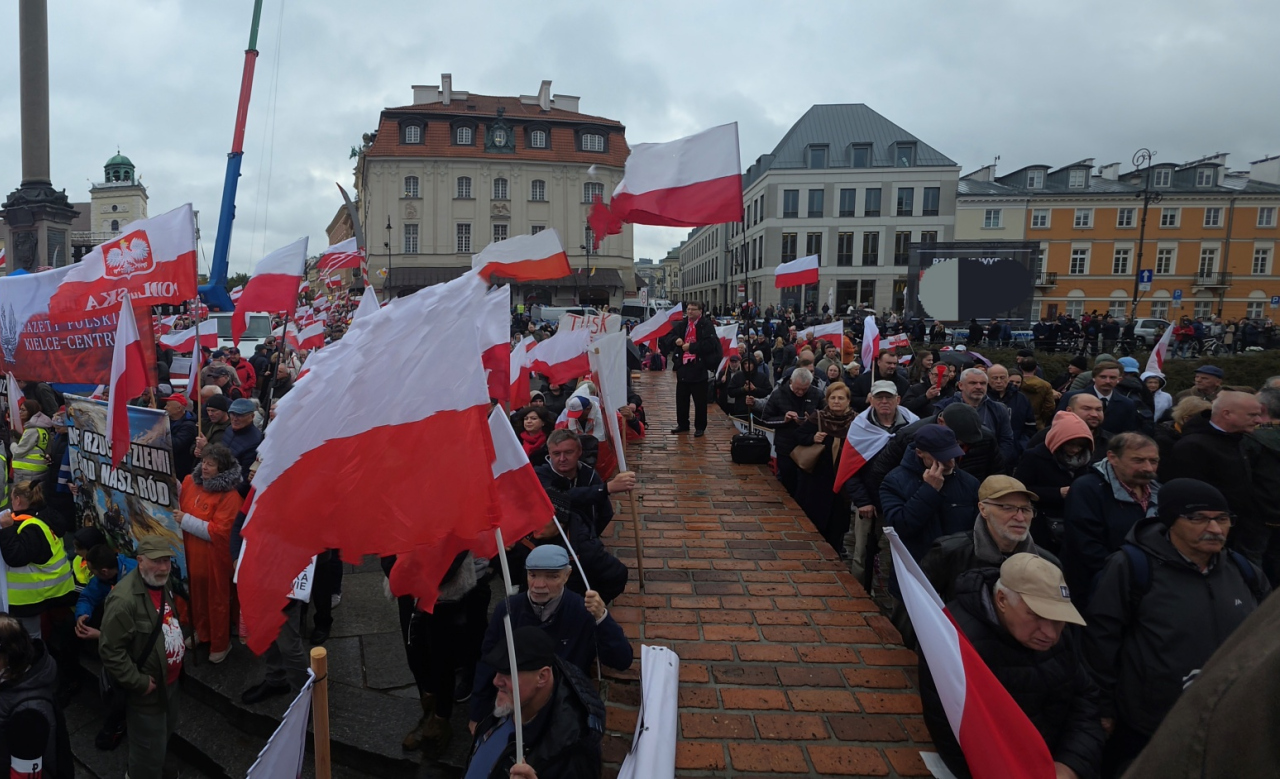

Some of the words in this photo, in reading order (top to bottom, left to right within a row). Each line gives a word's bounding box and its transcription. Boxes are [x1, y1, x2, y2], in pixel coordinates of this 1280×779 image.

[67, 312, 118, 330] POLSKI
[42, 432, 48, 443] R
[131, 444, 171, 475] ZIEMI
[100, 463, 135, 495] NASZ
[136, 475, 171, 506] RÓD
